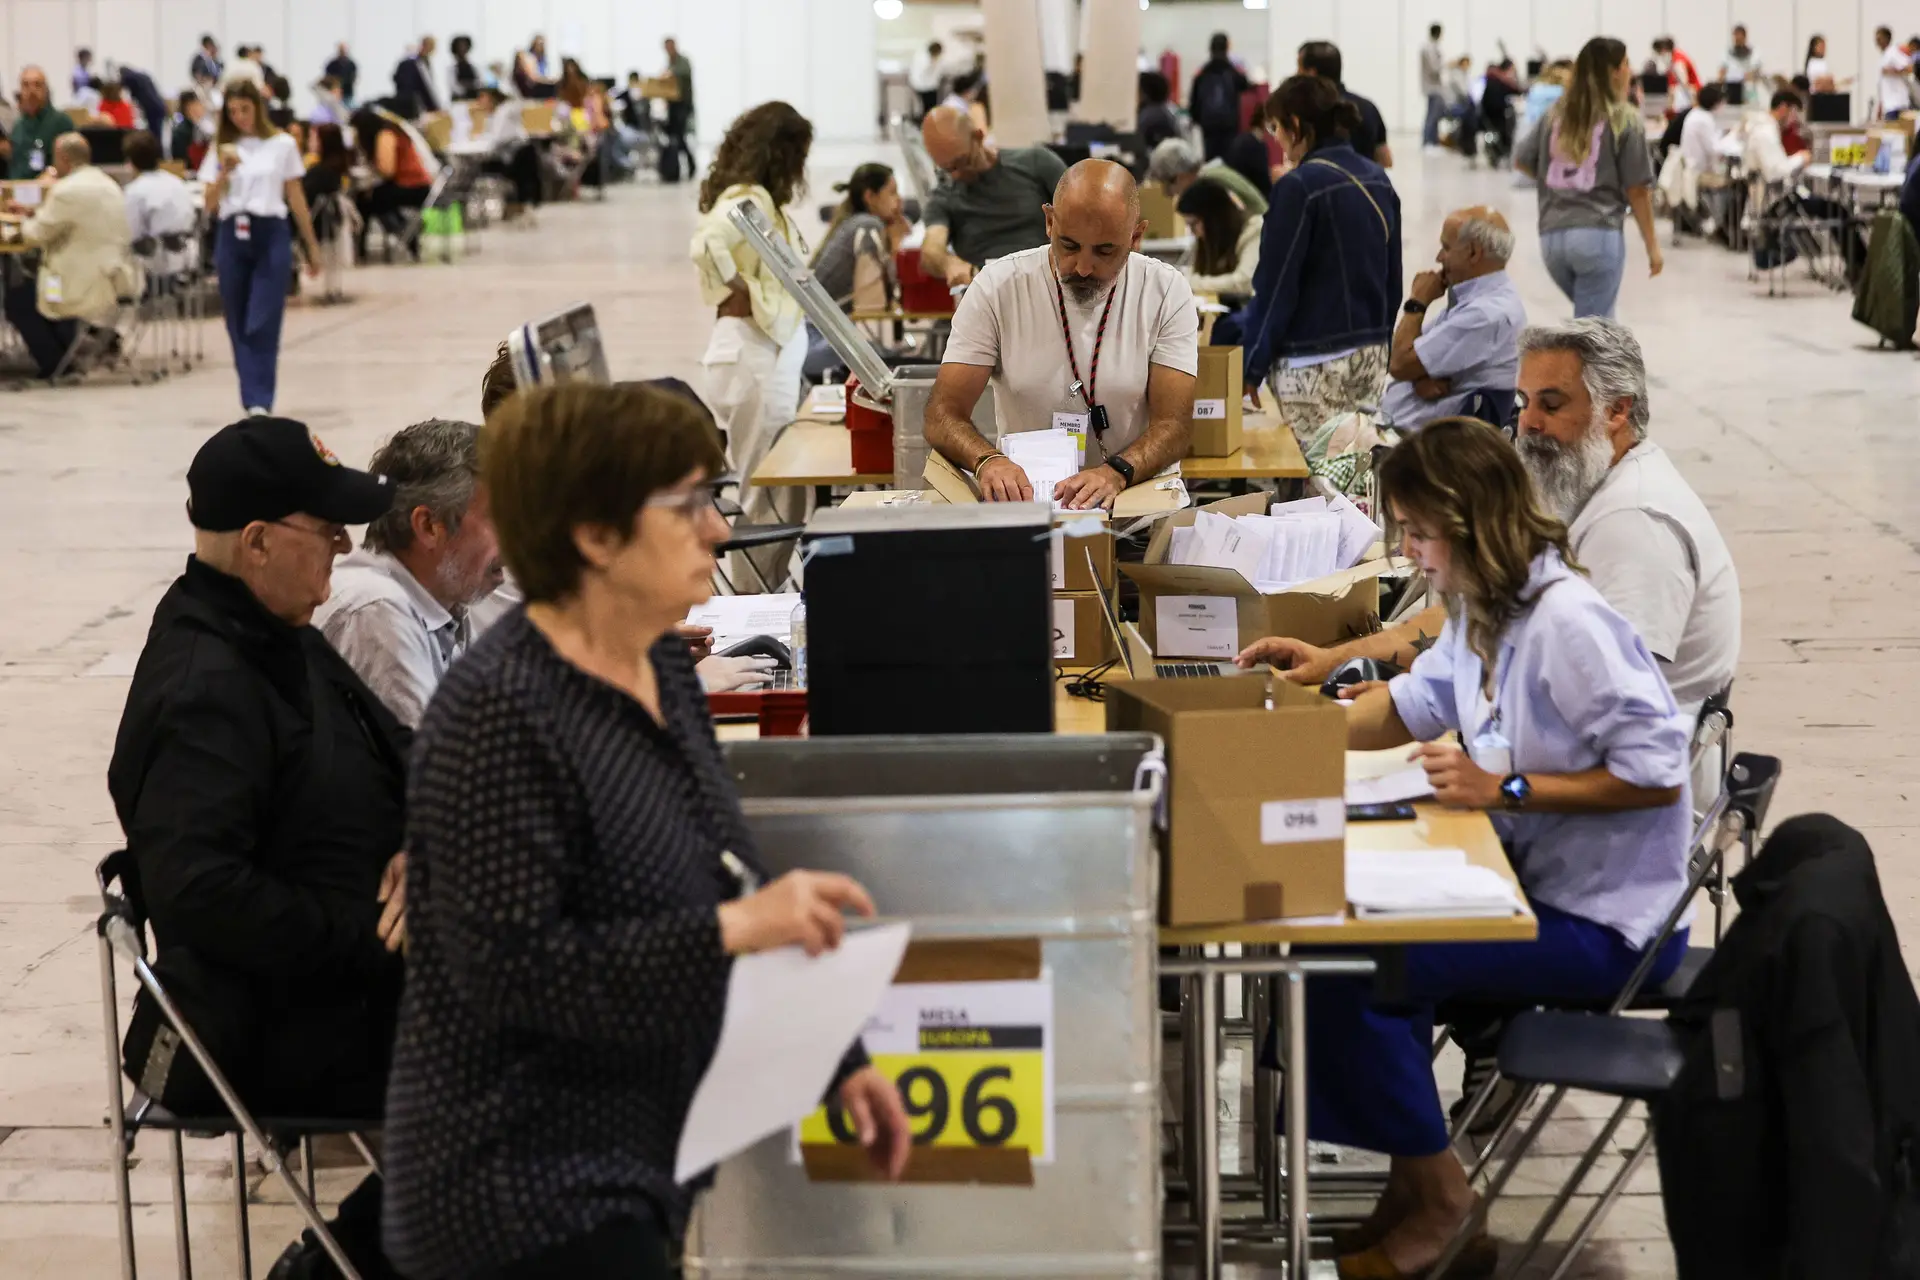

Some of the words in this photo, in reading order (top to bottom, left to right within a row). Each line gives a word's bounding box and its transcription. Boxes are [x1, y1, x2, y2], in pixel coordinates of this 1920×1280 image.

[1197, 407, 1214, 416] 087
[1059, 421, 1081, 429] MEMBRO
[918, 1007, 969, 1022] MESA
[919, 1029, 993, 1046] EUROPA
